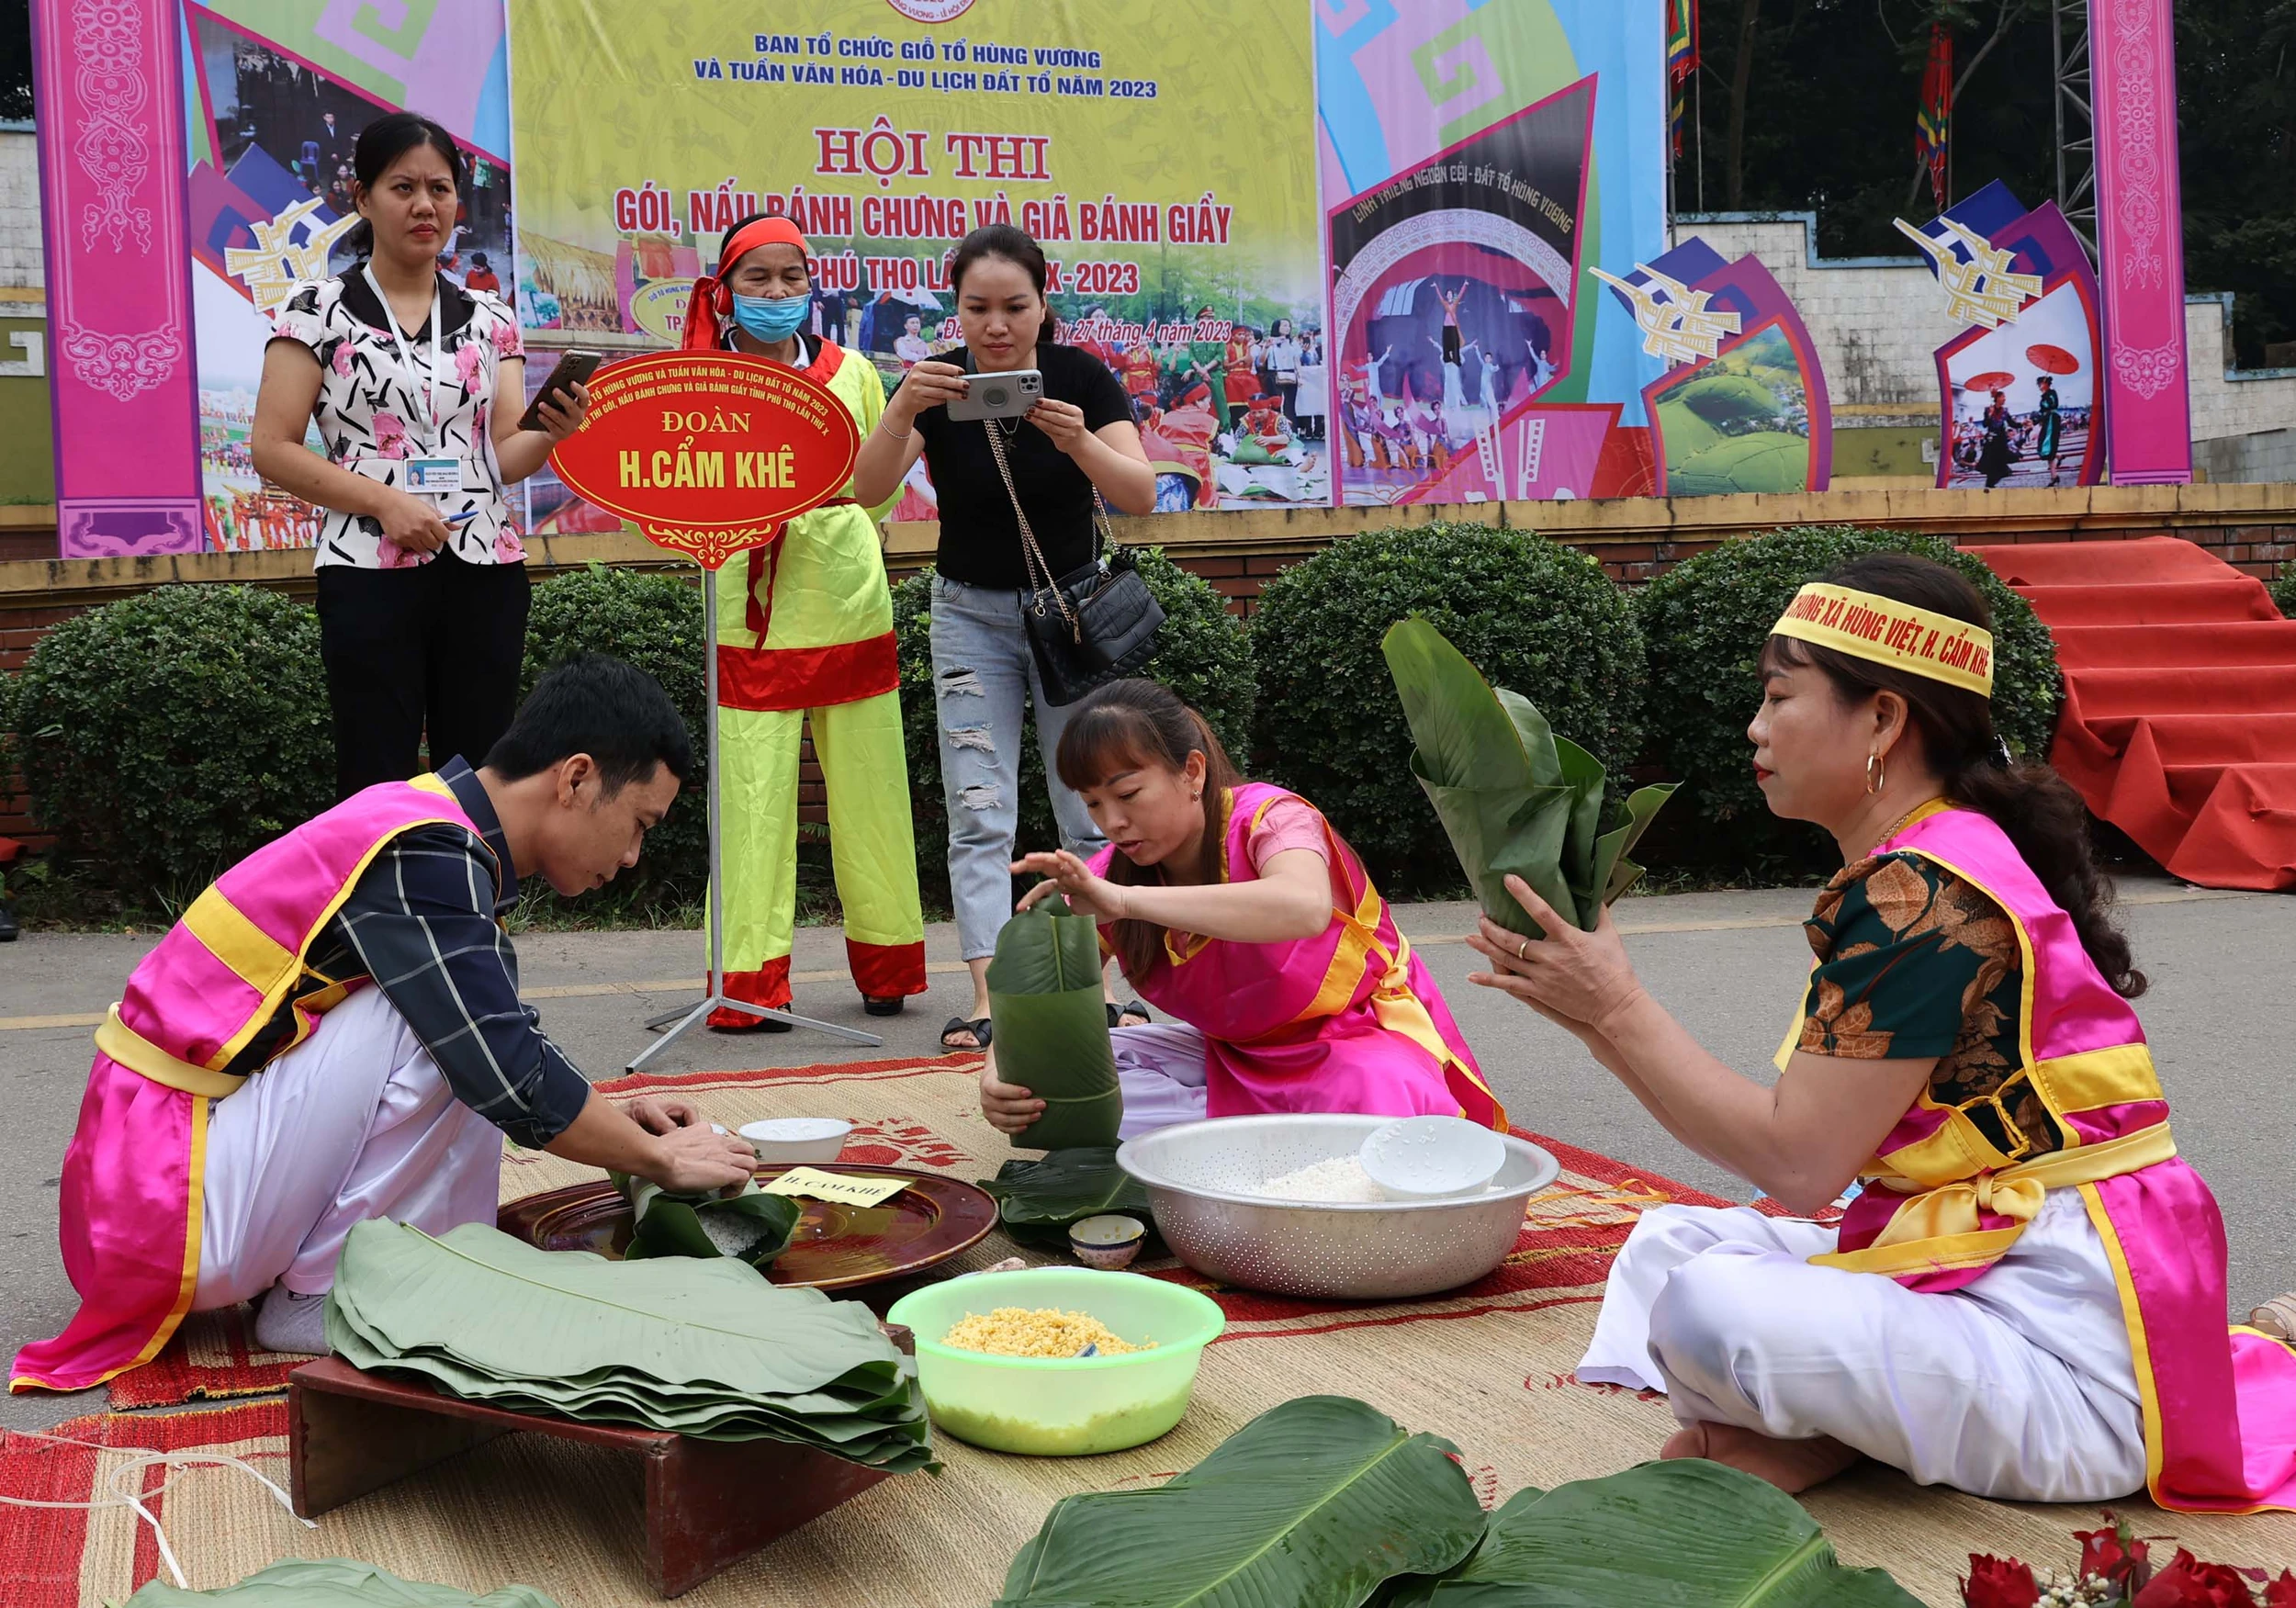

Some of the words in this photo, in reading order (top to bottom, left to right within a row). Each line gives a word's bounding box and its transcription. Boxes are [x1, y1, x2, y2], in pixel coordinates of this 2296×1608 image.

[754, 35, 799, 54] BAN
[805, 31, 831, 55] TỔ
[838, 37, 894, 58] CHỨC
[901, 37, 935, 60] GIỖ
[941, 38, 966, 62] TỔ
[973, 42, 1028, 65] HÙNG
[1033, 49, 1100, 68] VƯƠNG
[694, 58, 723, 79] VÀ
[728, 57, 785, 82] TUẦN
[791, 62, 835, 84] VĂN
[840, 65, 884, 86] HÓA
[897, 70, 925, 88] DU
[931, 72, 976, 94] LỊCH
[983, 69, 1020, 92] ĐẤT
[1027, 70, 1052, 94] TỔ
[1057, 75, 1103, 96] NĂM
[1109, 80, 1157, 98] 2023
[815, 117, 929, 187] HỘI
[947, 134, 1050, 179] THI
[616, 182, 681, 237] GÓI,
[690, 178, 756, 232] NẤU
[862, 195, 965, 238] CHƯNG
[974, 192, 1014, 228] VÀ
[1021, 195, 1072, 241] GIÃ
[1079, 196, 1159, 242] BÁNH
[1167, 193, 1232, 243] GIẦY
[1511, 179, 1543, 208] HÙNG
[1539, 196, 1573, 234] VƯƠNG
[806, 250, 859, 290] PHÚ
[866, 258, 914, 297] THỌ
[1074, 320, 1095, 341] 27
[1097, 318, 1142, 346] tháng
[1145, 321, 1154, 341] 4
[1158, 322, 1192, 342] năm
[1196, 321, 1232, 343] 2023
[590, 407, 602, 422] THI
[603, 399, 618, 414] GÓI,
[617, 392, 634, 406] NẤU
[635, 388, 656, 400] BÁNH
[657, 383, 681, 396] CHƯNG
[683, 382, 693, 392] VÀ
[695, 381, 707, 392] GIÃ
[709, 382, 729, 393] BÁNH
[748, 387, 766, 400] TỈNH
[766, 392, 782, 405] PHÚ
[782, 399, 796, 413] THỌ
[811, 415, 825, 430] THỨ
[821, 425, 830, 436] X
[591, 387, 602, 402] TỔ
[602, 379, 625, 396] HÙNG
[625, 371, 654, 386] VƯƠNG
[655, 367, 667, 379] VÀ
[691, 365, 707, 377] VĂN
[710, 366, 726, 378] HÓA
[733, 369, 744, 379] DU
[746, 372, 764, 385] LỊCH
[765, 376, 782, 389] ĐẤT
[782, 382, 793, 394] TỔ
[792, 387, 811, 403] NĂM
[810, 399, 829, 417] 2023
[661, 405, 751, 433] ĐOÀN
[619, 435, 725, 489] H.CẨM
[736, 444, 796, 489] KHÊ
[1818, 597, 1849, 629] XÃ
[1839, 602, 1887, 642] HÙNG
[1884, 616, 1925, 657] VIỆT,
[1919, 629, 1940, 658] H.
[1939, 628, 1975, 670] CẨM
[784, 1175, 799, 1185] H.
